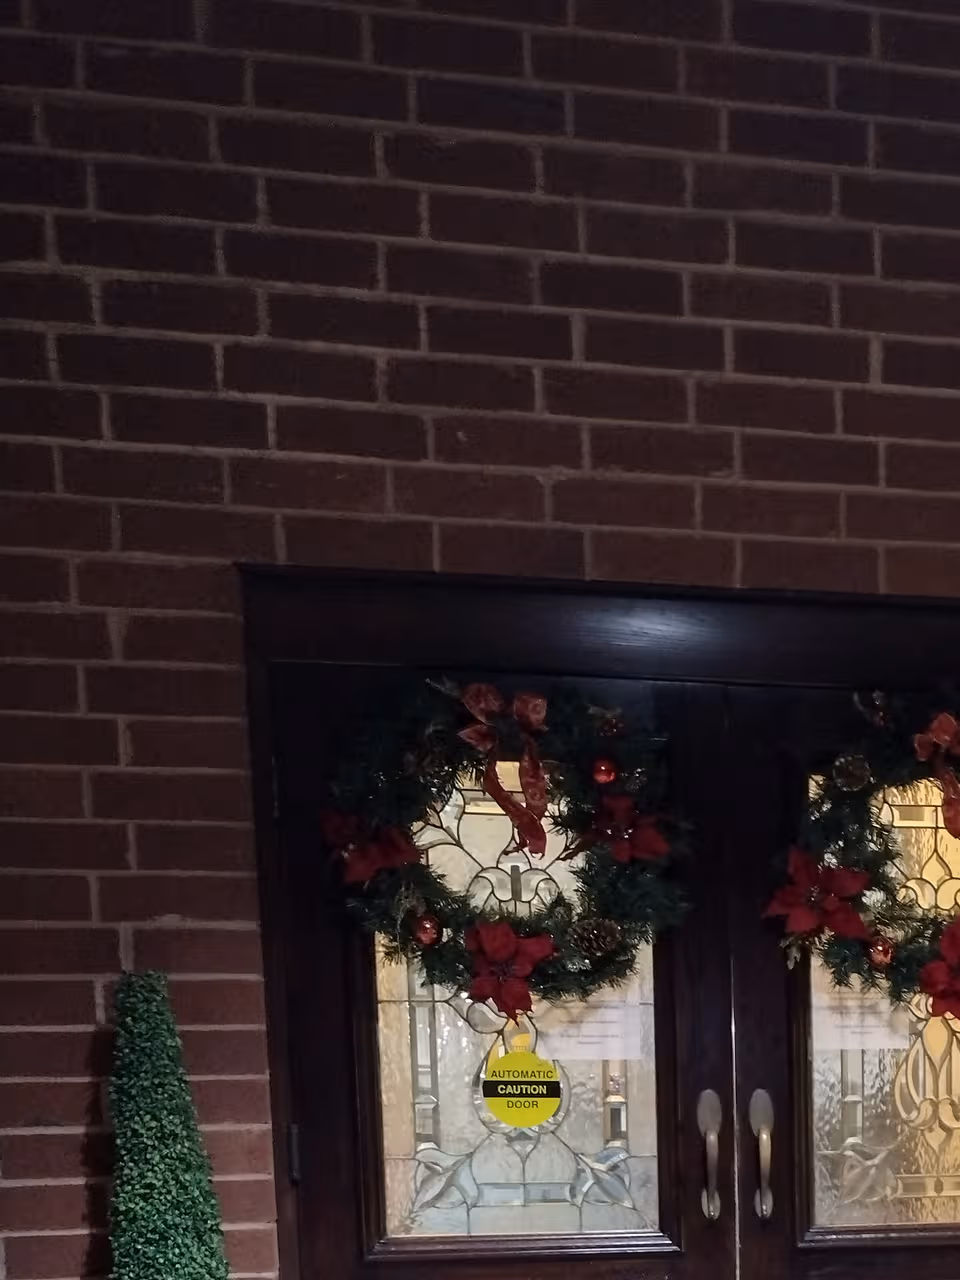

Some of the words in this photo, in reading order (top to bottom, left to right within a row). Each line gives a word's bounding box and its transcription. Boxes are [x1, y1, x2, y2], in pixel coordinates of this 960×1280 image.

[491, 1070, 554, 1079] AUTOMATIC
[497, 1085, 547, 1095] CAUTION
[507, 1100, 539, 1109] DOOR
